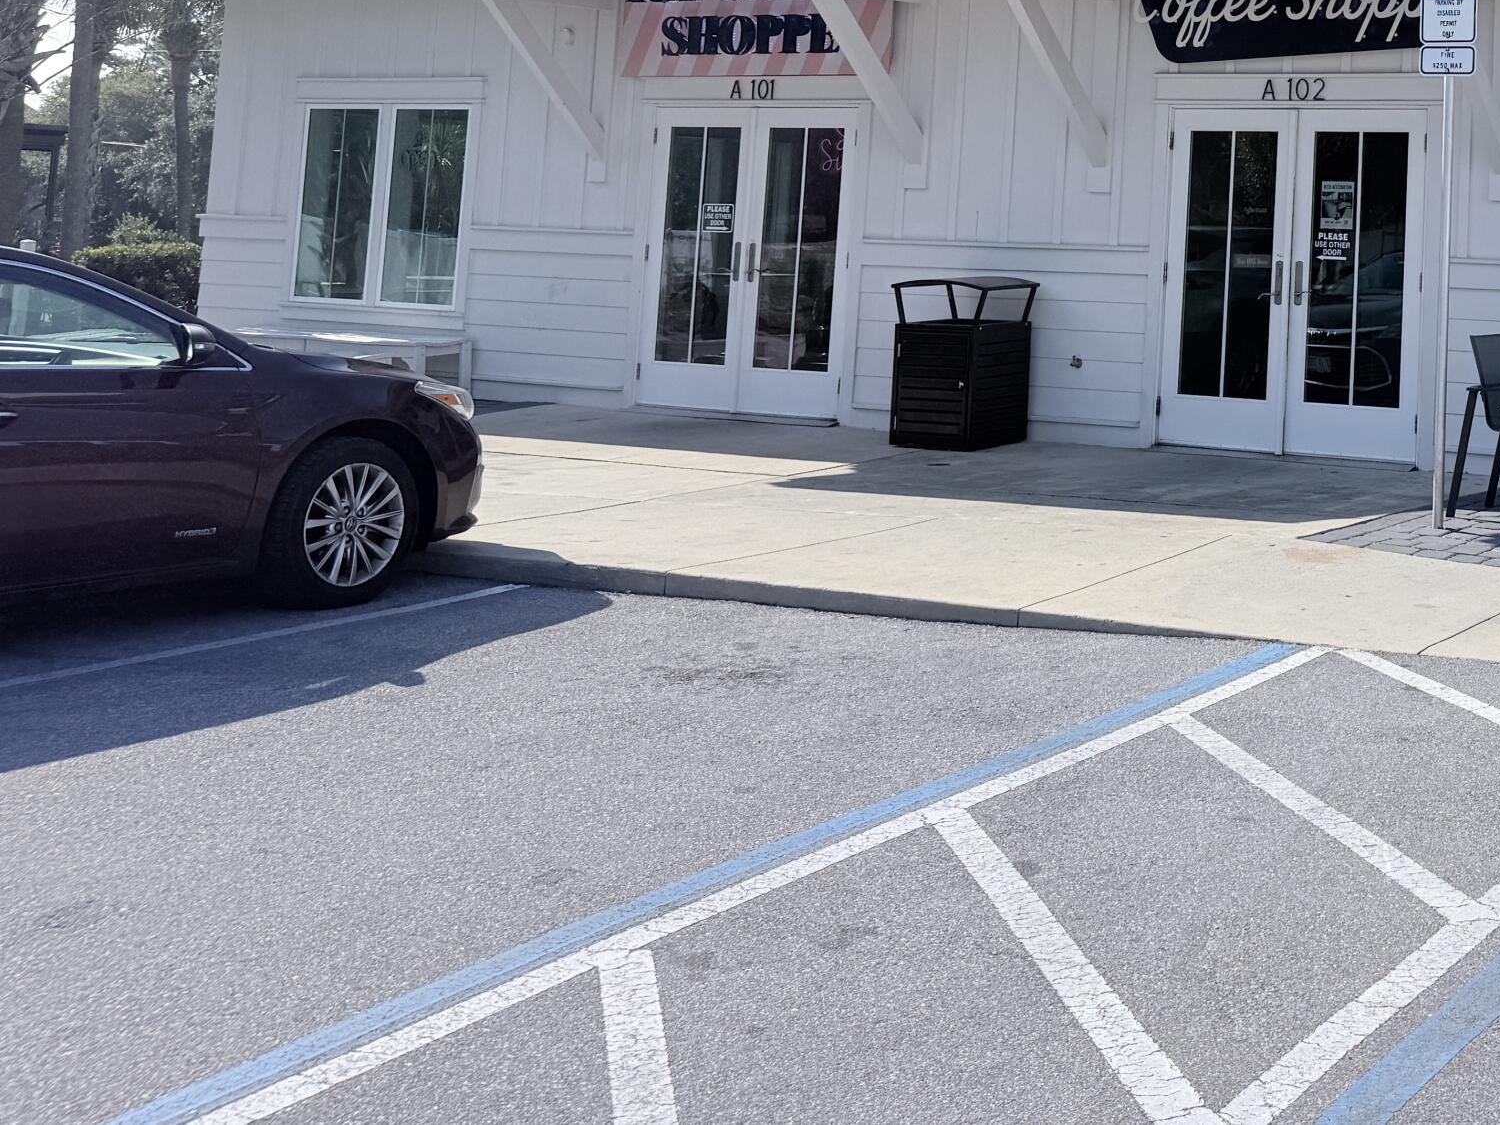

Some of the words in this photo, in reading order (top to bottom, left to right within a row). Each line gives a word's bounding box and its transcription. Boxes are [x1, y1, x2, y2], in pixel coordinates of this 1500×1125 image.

[661, 13, 840, 56] SHOPPE
[730, 80, 741, 99] A
[750, 79, 776, 99] 101
[1261, 79, 1276, 101] A
[1287, 78, 1326, 101] 102
[1318, 232, 1348, 241] PLEASE
